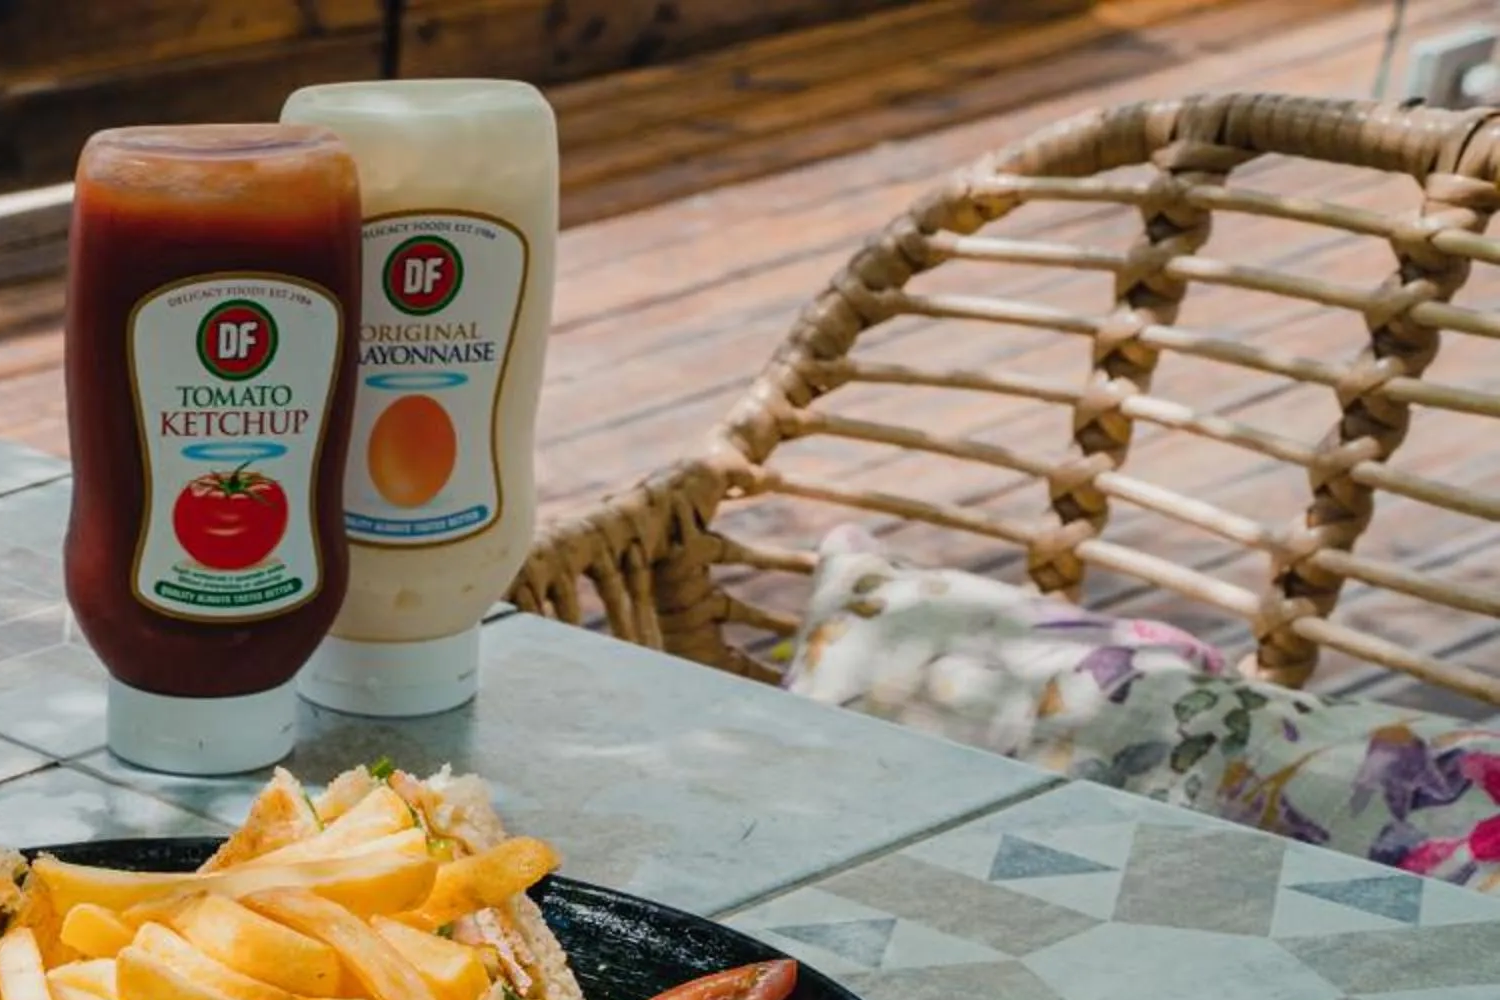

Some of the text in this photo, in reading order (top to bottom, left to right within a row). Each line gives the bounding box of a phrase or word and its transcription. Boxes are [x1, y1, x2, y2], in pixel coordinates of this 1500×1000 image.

[403, 257, 444, 294] DF
[218, 321, 258, 359] DF
[358, 321, 482, 343] ORIGINAL
[176, 384, 293, 408] TOMATO
[160, 409, 310, 438] KETCHUP
